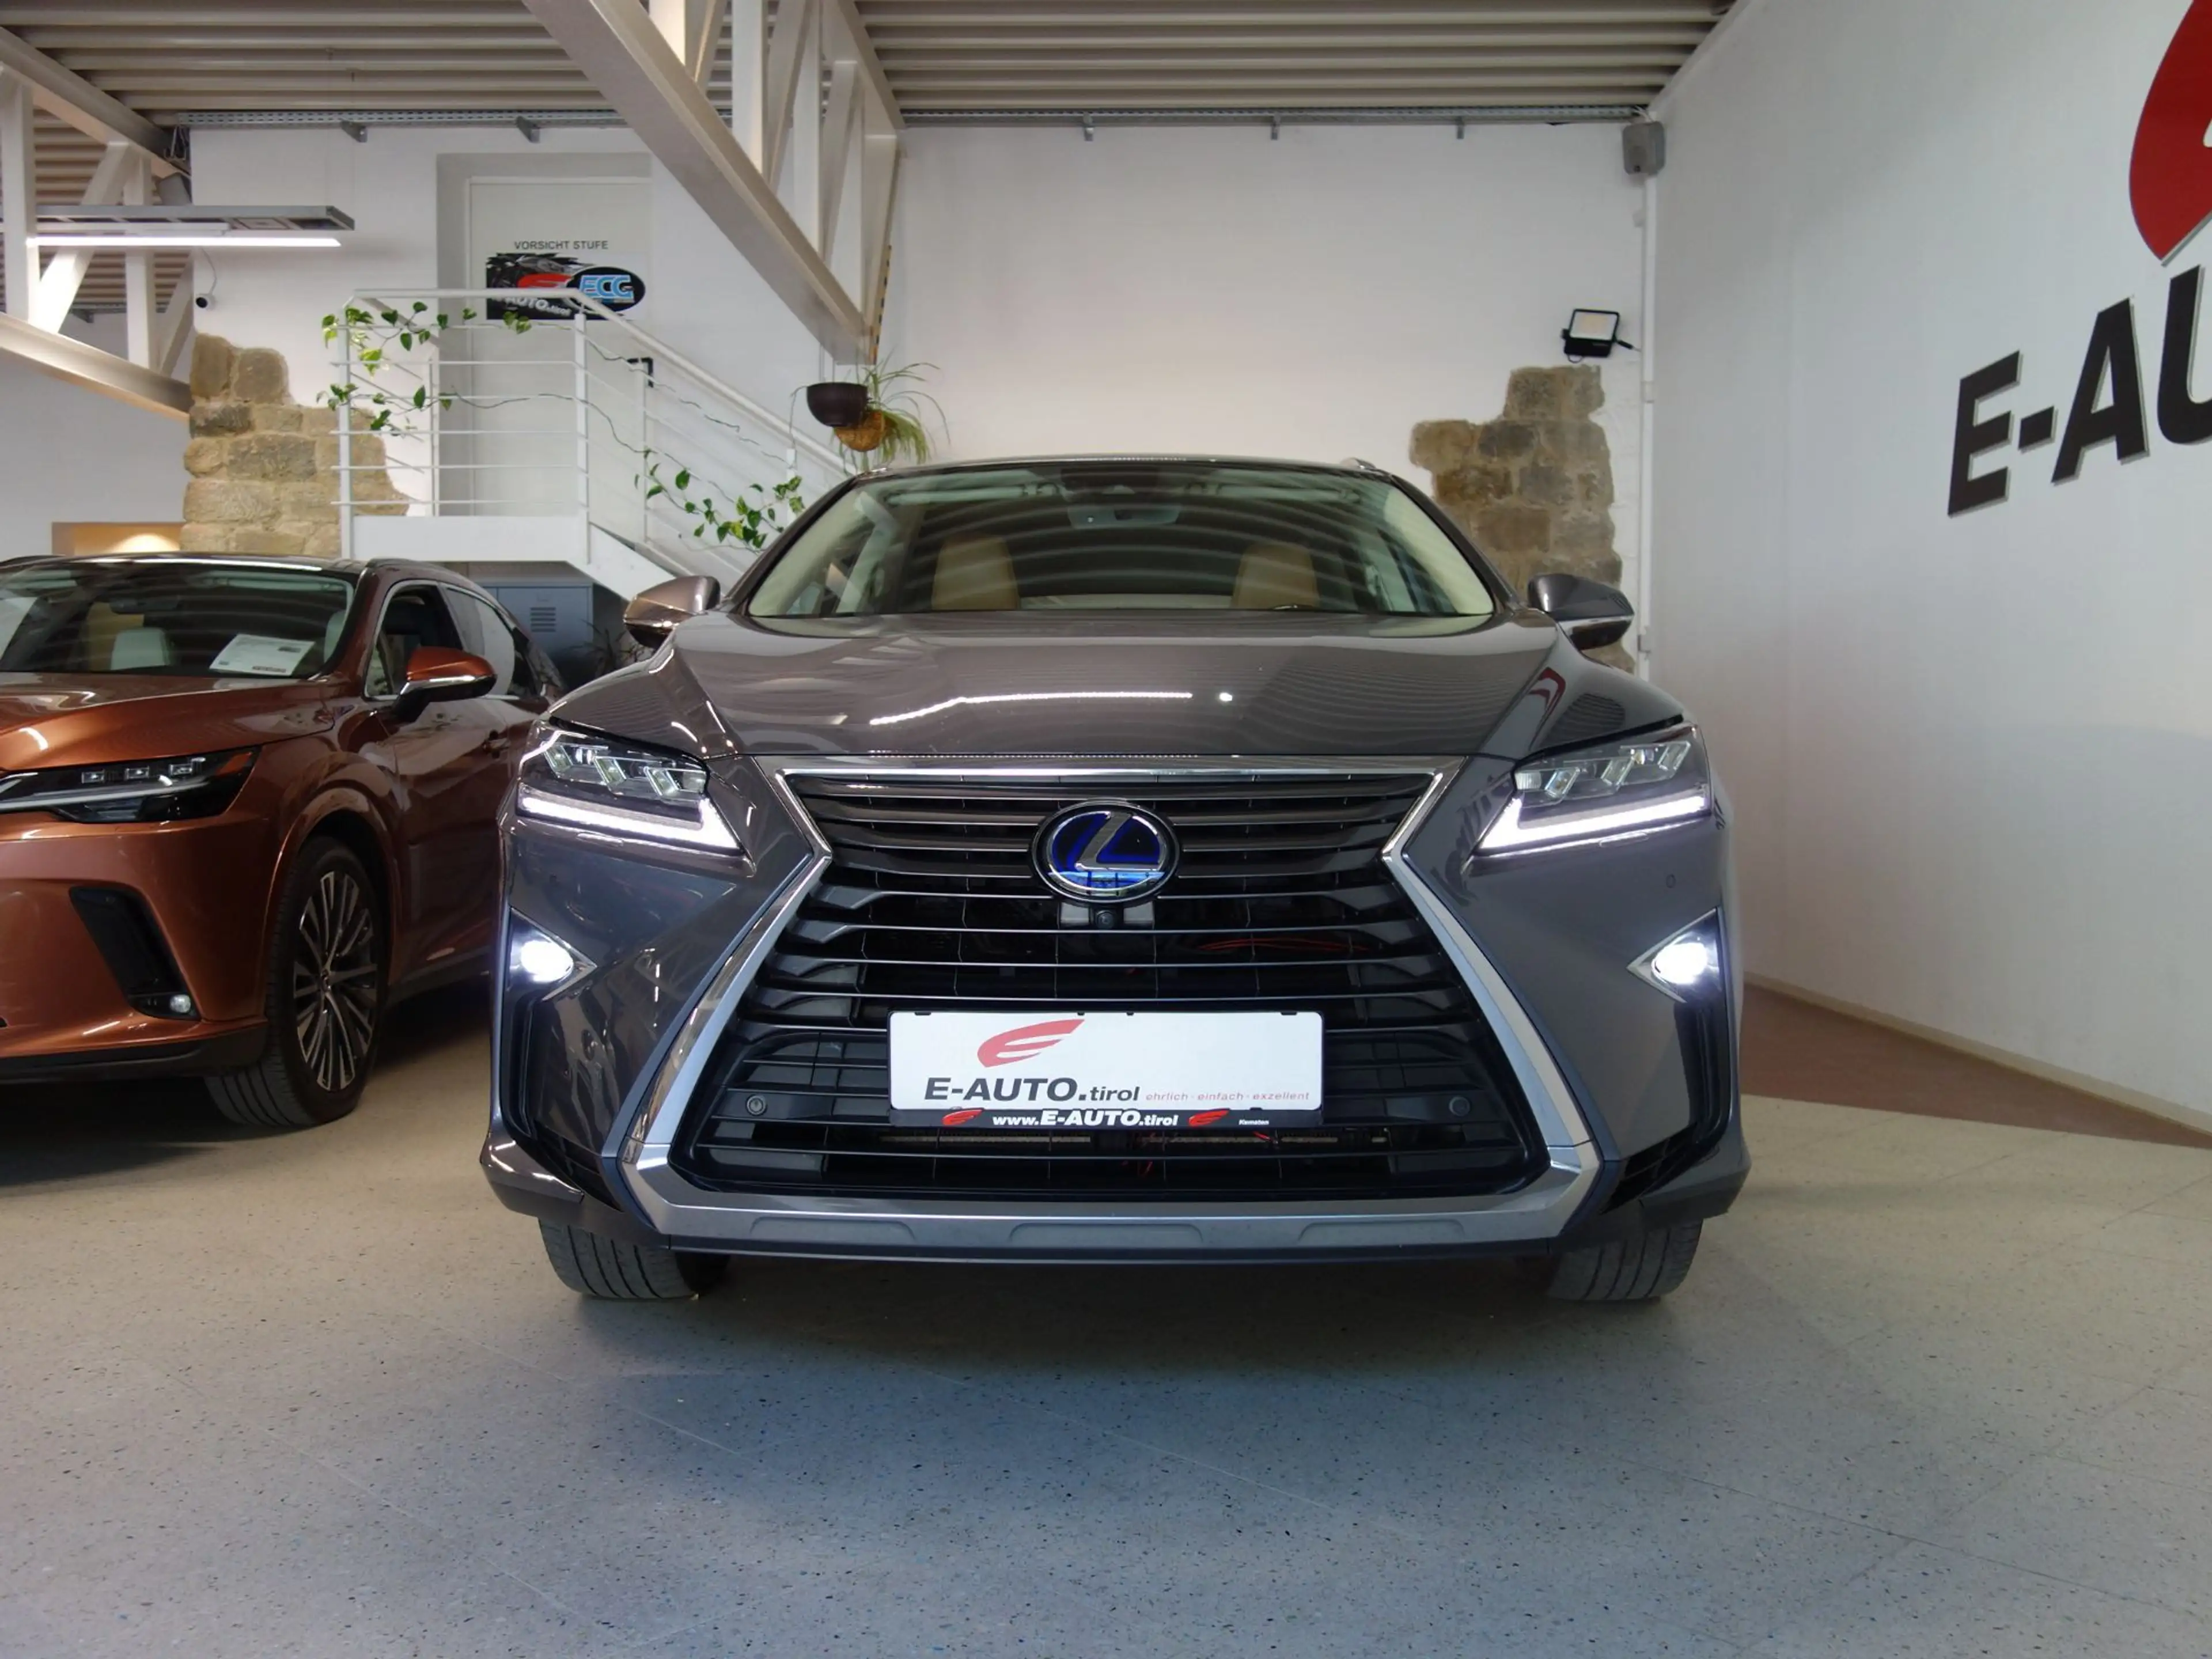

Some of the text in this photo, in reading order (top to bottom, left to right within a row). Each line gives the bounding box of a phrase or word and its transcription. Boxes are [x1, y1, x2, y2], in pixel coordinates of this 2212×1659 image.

[514, 240, 608, 249] VORSICHT STUFE
[924, 1077, 1309, 1101] E-AUTO.tirol ehrlich einfach exzellent
[992, 1110, 1179, 1127] www.E-AUTO.tirol
